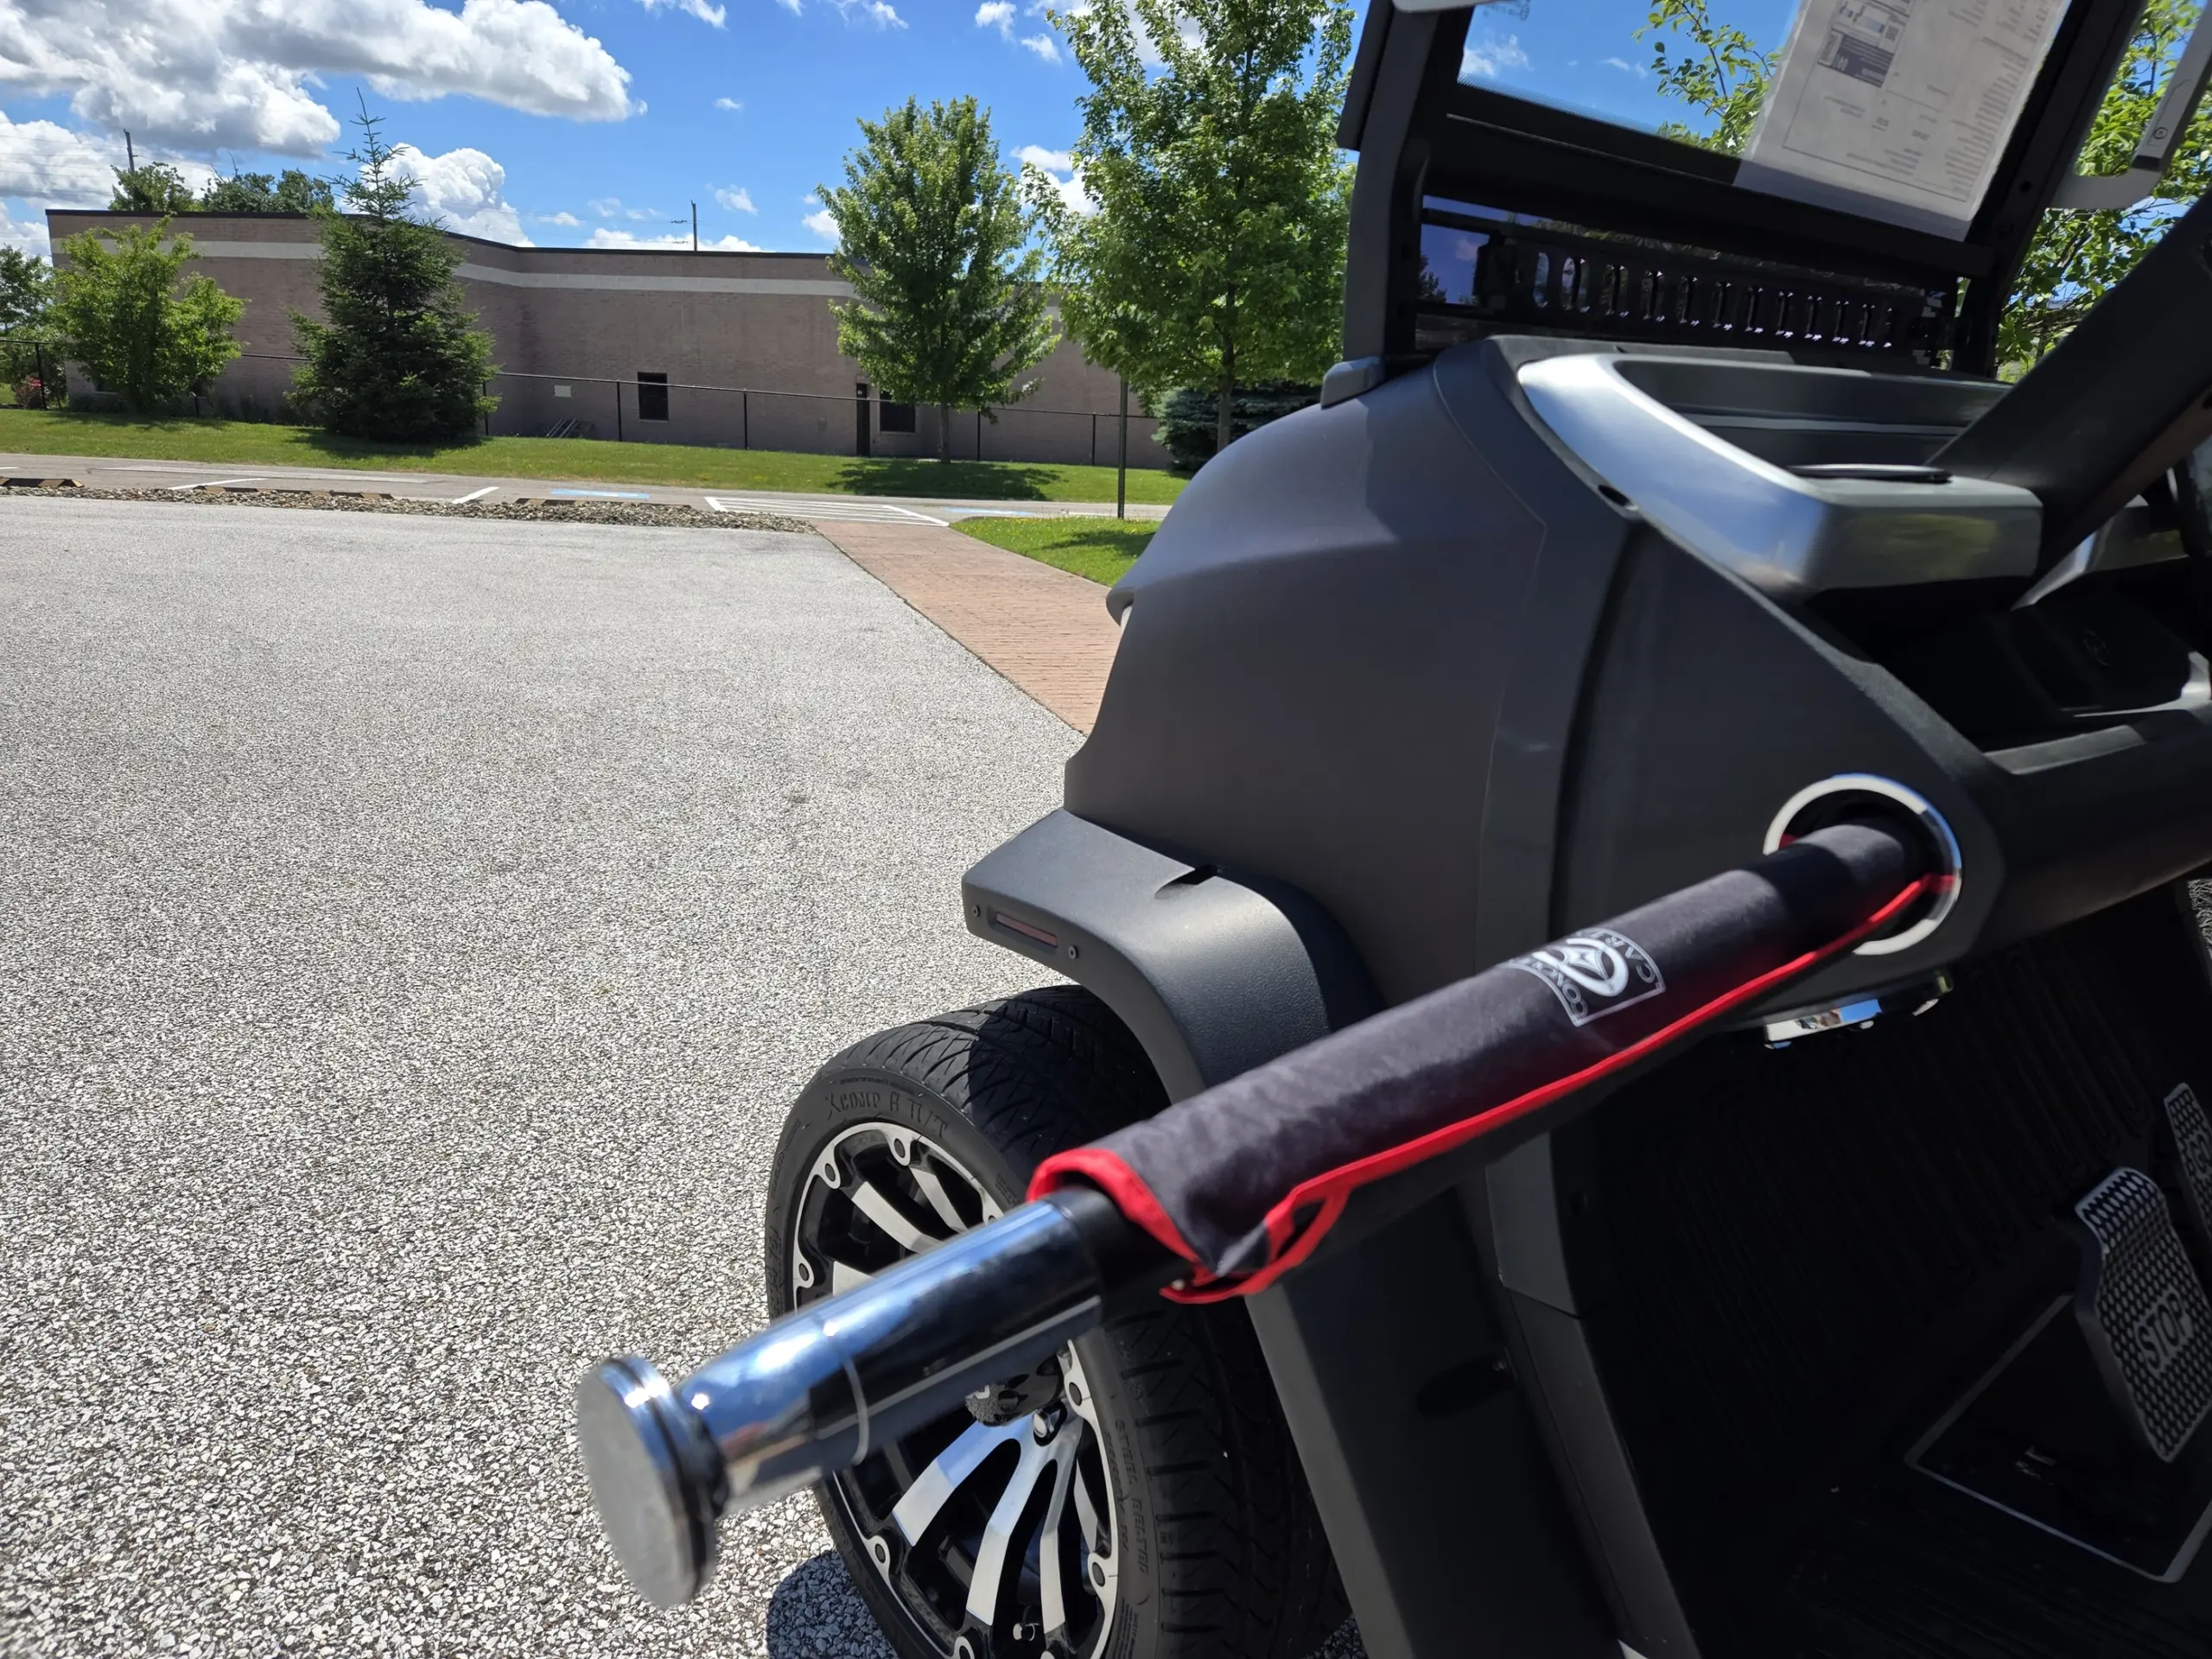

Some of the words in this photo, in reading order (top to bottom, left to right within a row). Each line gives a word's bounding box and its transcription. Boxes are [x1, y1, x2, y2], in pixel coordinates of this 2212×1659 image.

[2138, 1293, 2186, 1370] STOP
[1115, 1418, 1138, 1485] STEEL
[1131, 1497, 1149, 1575] BELTED
